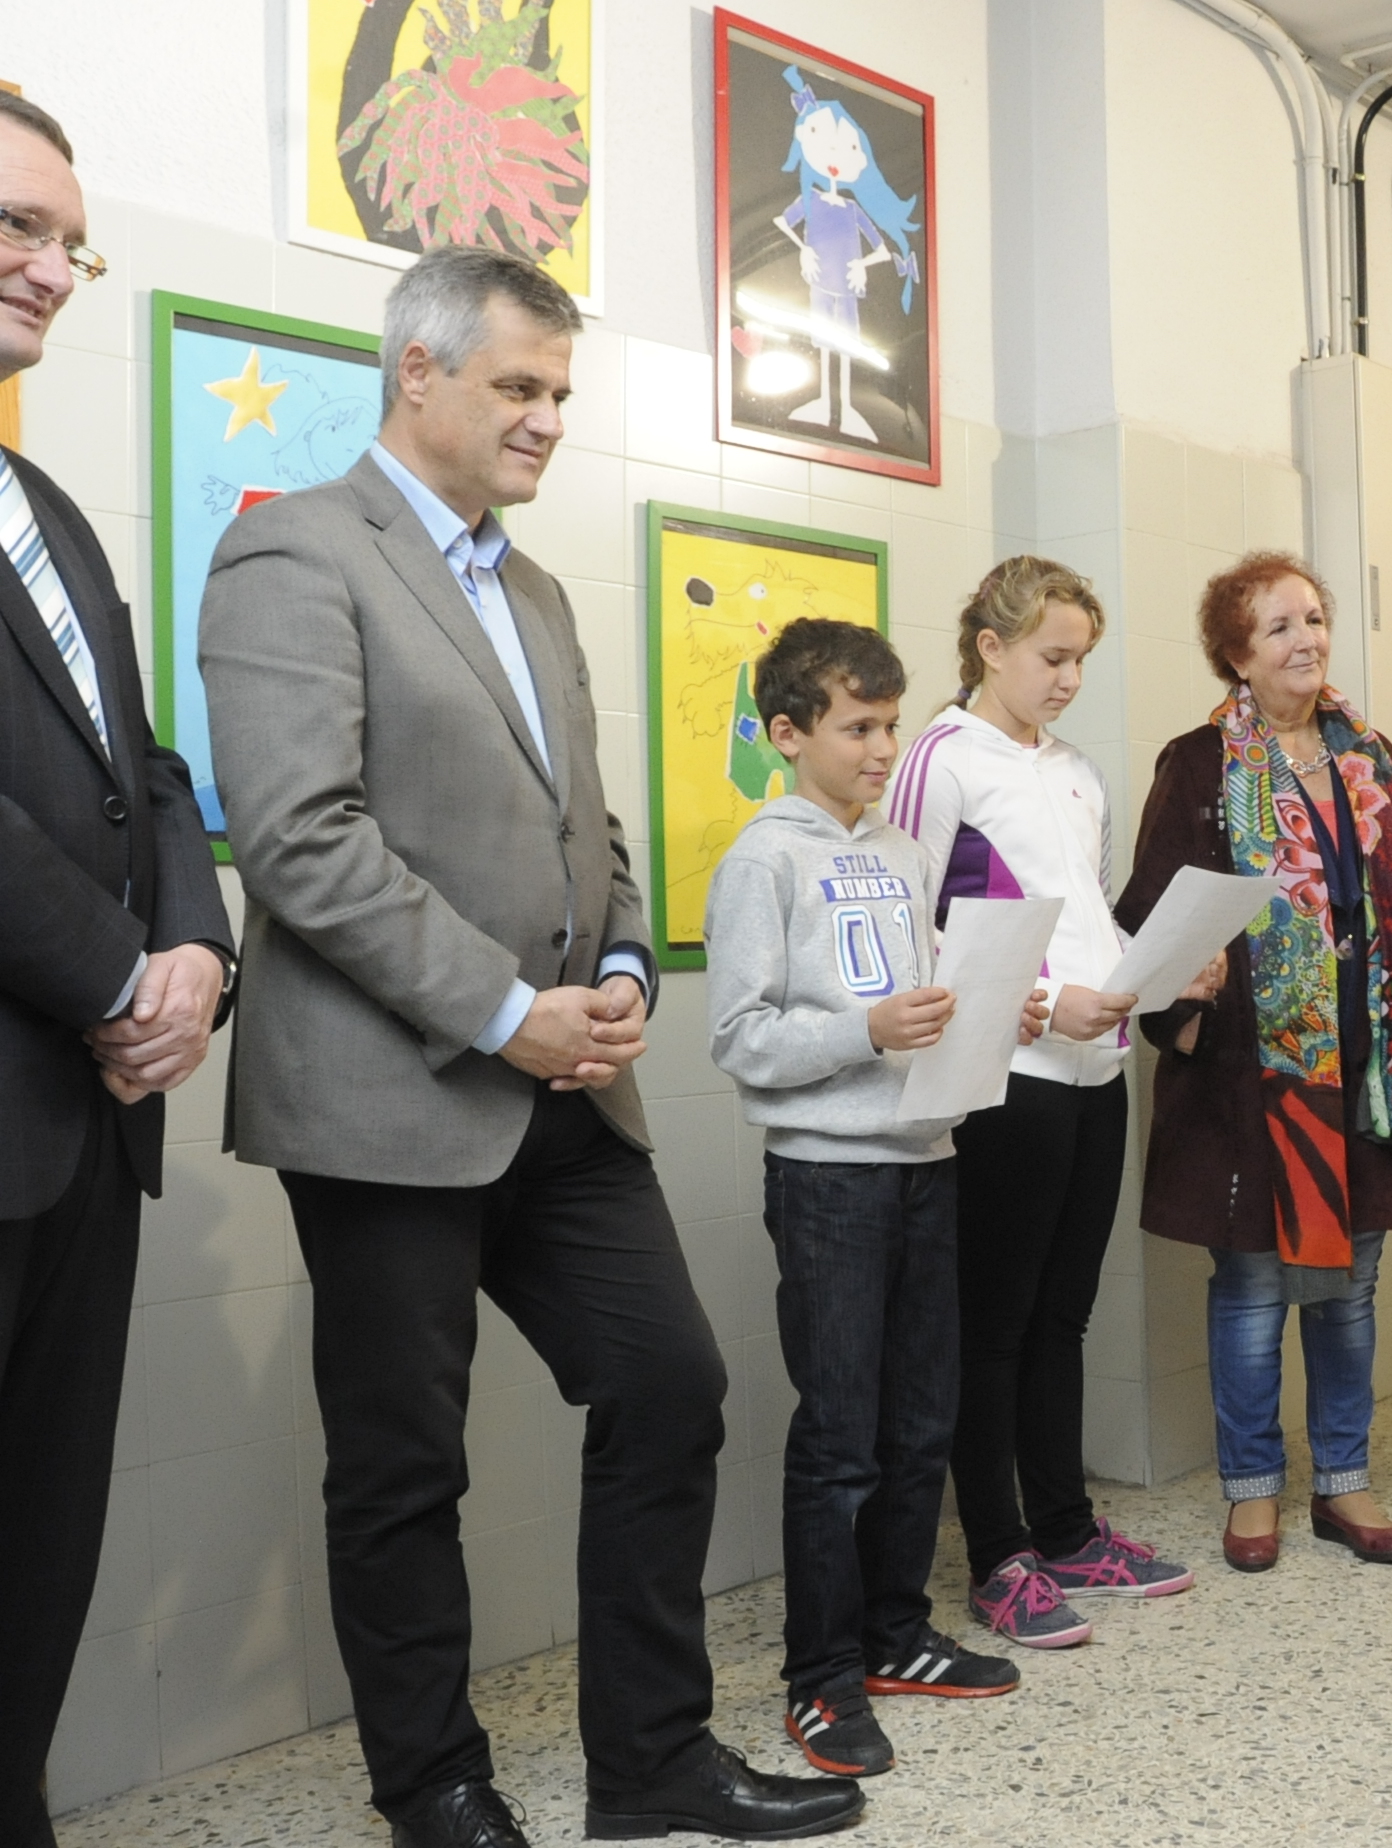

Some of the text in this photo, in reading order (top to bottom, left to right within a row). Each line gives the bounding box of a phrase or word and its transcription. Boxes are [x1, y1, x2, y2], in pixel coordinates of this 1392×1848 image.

[832, 854, 888, 875] STILL
[829, 876, 906, 900] NUMBER
[831, 902, 921, 998] 01
